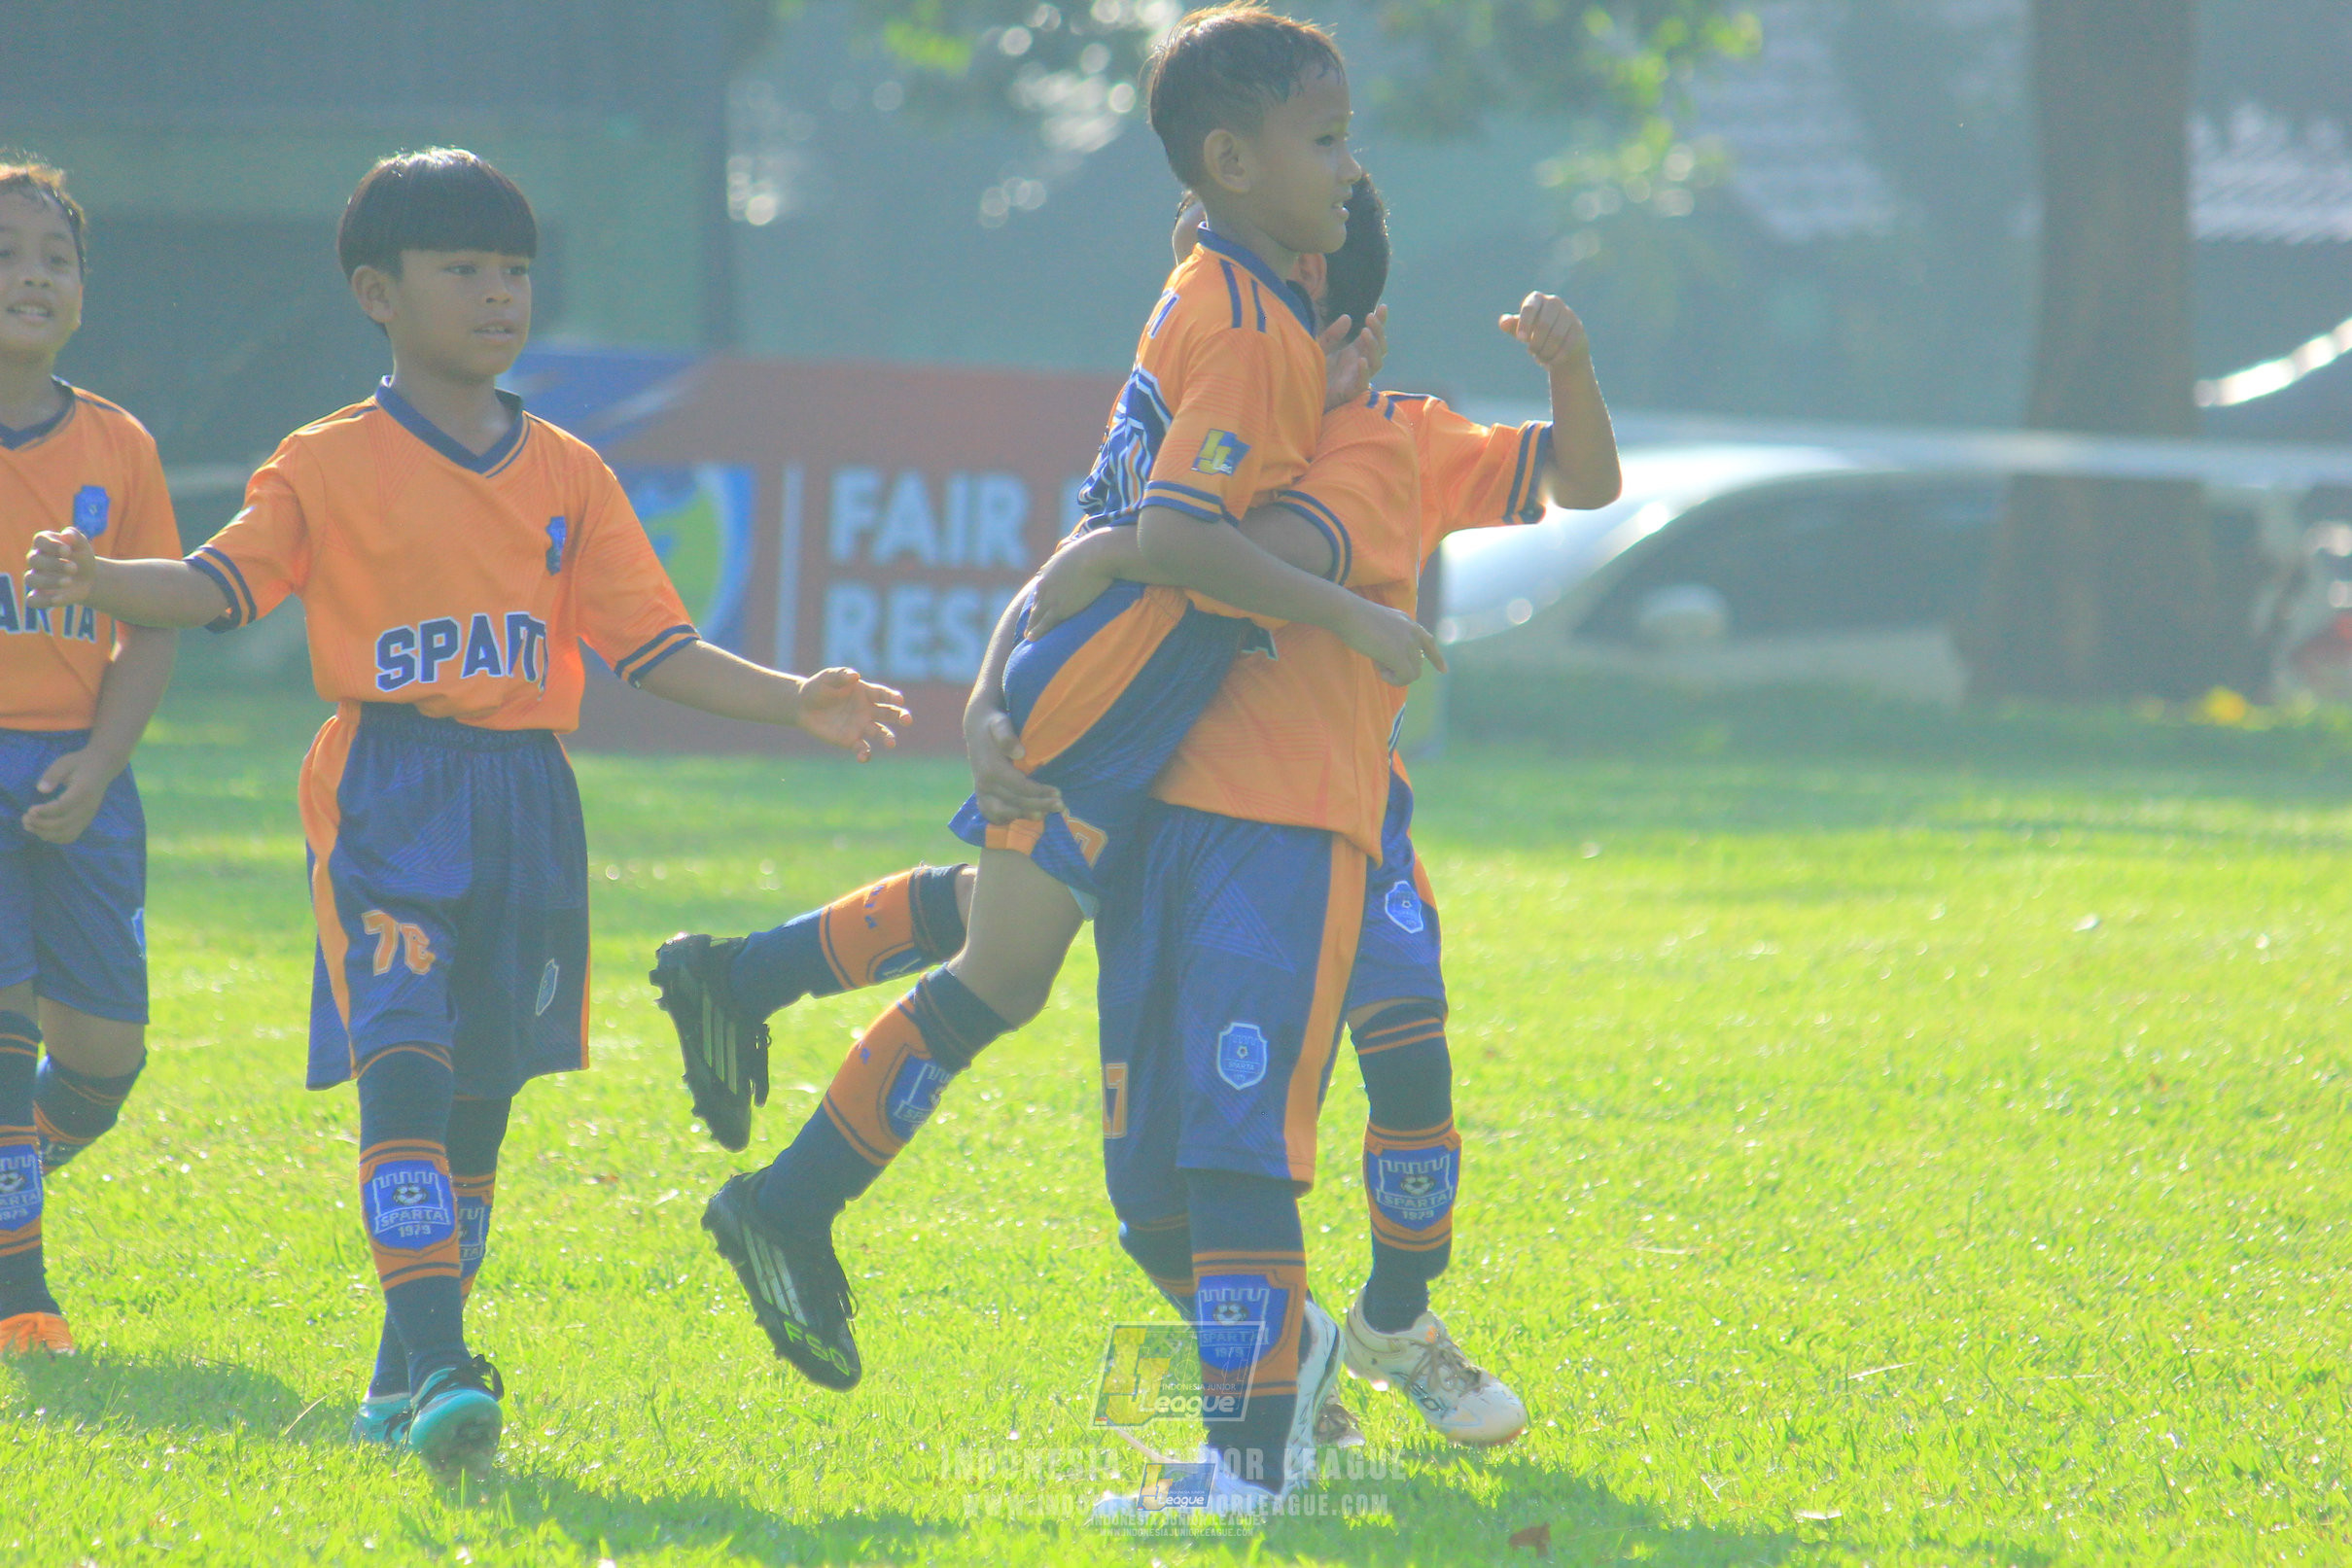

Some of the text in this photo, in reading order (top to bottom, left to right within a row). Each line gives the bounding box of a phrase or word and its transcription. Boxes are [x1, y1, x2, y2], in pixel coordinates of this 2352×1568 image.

[829, 467, 1031, 570] FAIR
[375, 611, 548, 701] SPART
[380, 1208, 444, 1228] SPARTA
[1384, 1193, 1448, 1208] SPARTA
[398, 1225, 432, 1238] 1979
[783, 1321, 851, 1376] F50
